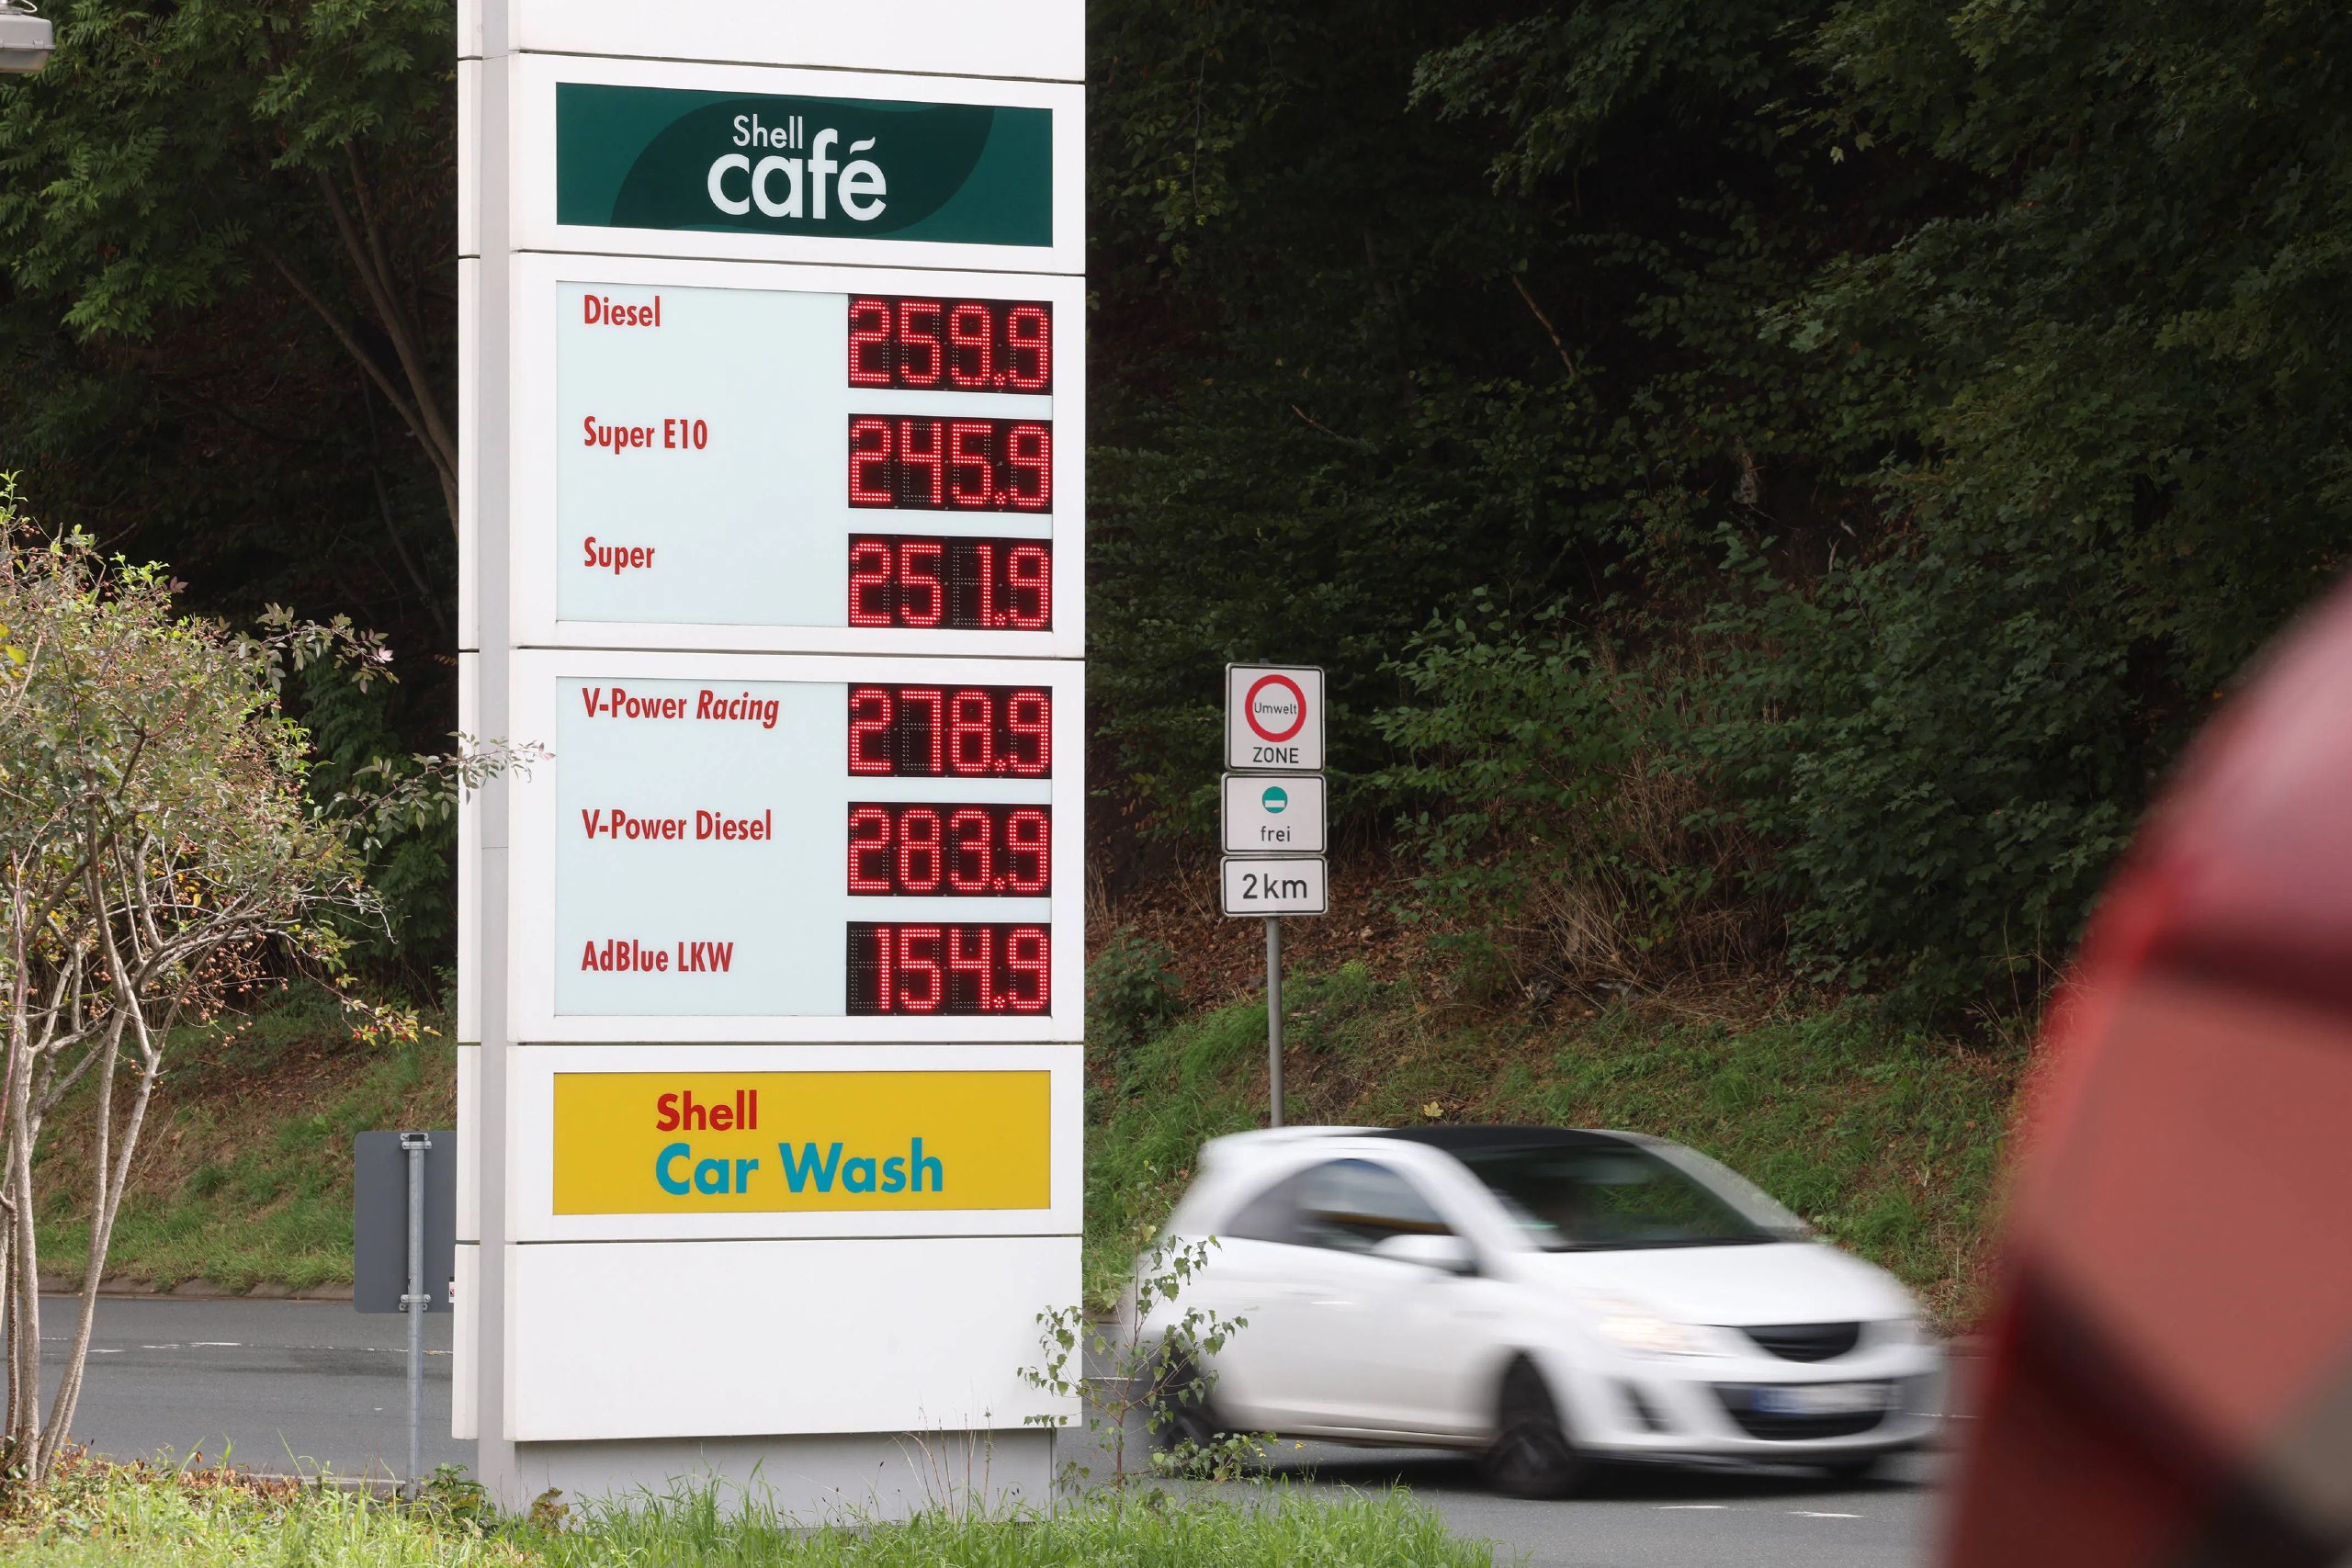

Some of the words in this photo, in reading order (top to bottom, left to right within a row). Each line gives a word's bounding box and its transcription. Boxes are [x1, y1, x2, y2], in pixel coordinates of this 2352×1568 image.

[732, 113, 804, 150] Shell
[707, 128, 888, 221] café
[583, 294, 661, 327] Diesel
[849, 299, 1050, 389] 259.9
[583, 416, 655, 454] Super
[663, 419, 707, 450] E10
[850, 419, 1051, 508] 245.9
[583, 536, 655, 575] Super
[850, 542, 1051, 628] 251.9
[582, 688, 686, 720] V-Power
[696, 690, 779, 728] Racing
[1254, 702, 1297, 715] Umwelt
[850, 689, 1050, 773] 278.9
[1252, 747, 1299, 764] ZONE
[582, 810, 687, 841] V-Power
[696, 810, 773, 841] Diesel
[1261, 826, 1291, 842] frei
[849, 808, 1049, 893] 283.9
[582, 939, 669, 972] AdBlue
[679, 942, 734, 973] LKW
[876, 928, 1049, 1011] 154.9
[656, 1089, 759, 1133] Shell
[655, 1142, 759, 1195] Car
[778, 1136, 943, 1193] Wash
